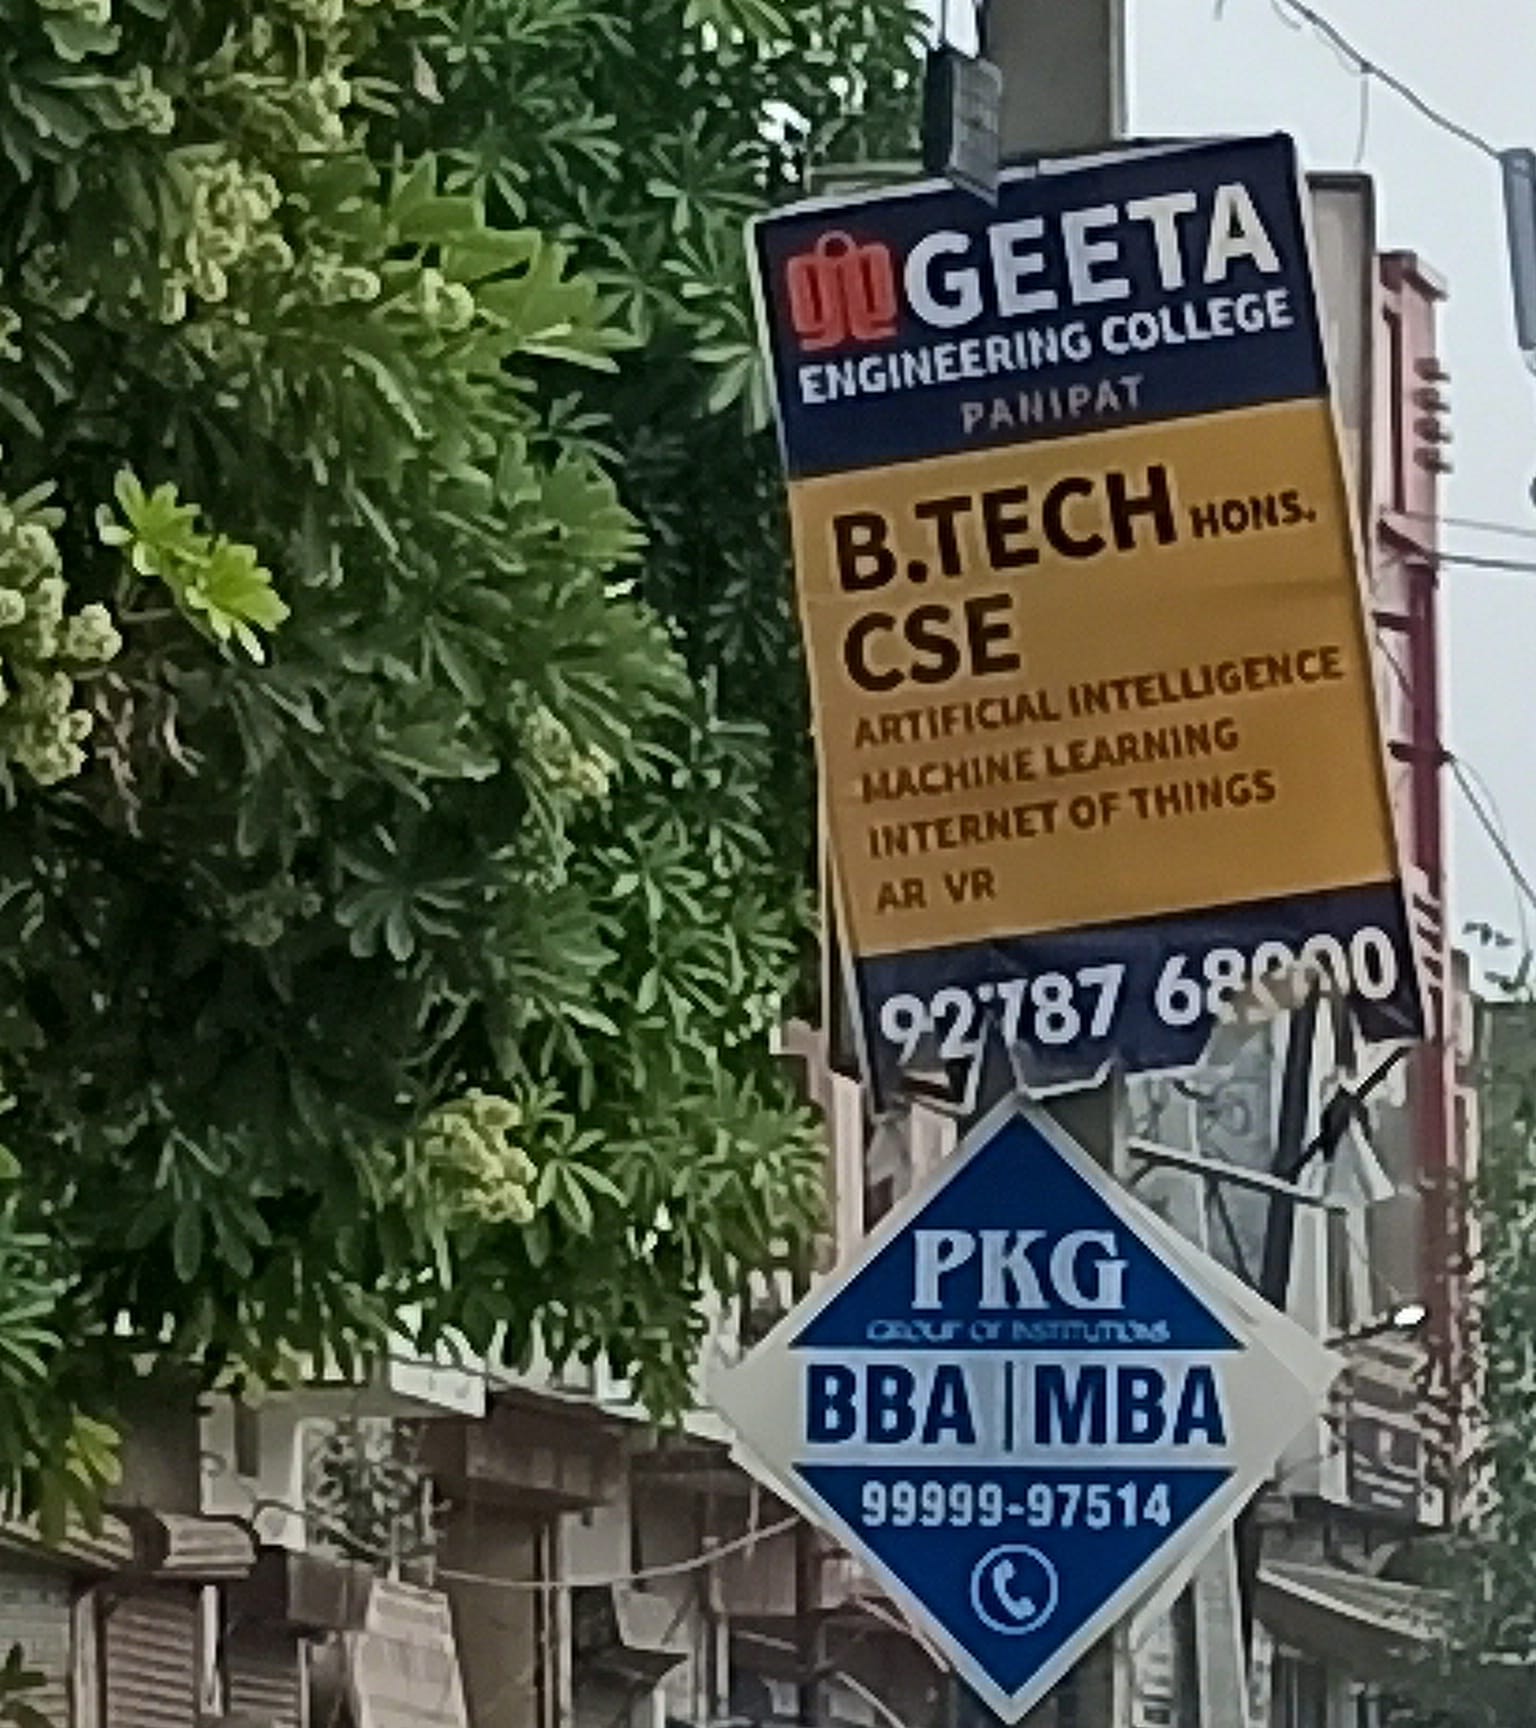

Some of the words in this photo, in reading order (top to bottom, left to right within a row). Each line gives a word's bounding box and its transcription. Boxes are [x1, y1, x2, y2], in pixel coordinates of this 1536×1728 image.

[905, 184, 1280, 330] GEETA
[799, 322, 1092, 403] ENGINEERING
[1101, 290, 1294, 356] COLLEGE
[961, 376, 1145, 434] PANIPAT
[832, 464, 1178, 592] B.TECH
[1190, 491, 1317, 538] HONS.
[843, 595, 1022, 692] CSE
[853, 692, 1061, 750] ARTIFICIAL
[1069, 647, 1344, 713] INTELLIGENCE
[862, 752, 1036, 803] MACHINE
[1044, 717, 1240, 777] LEARNING
[869, 802, 1059, 859] INTERNET
[1069, 791, 1120, 830] OF
[1129, 770, 1277, 822] THINGS
[876, 874, 928, 913] AR
[945, 869, 997, 905] VR
[911, 1229, 1127, 1310] PKG
[805, 1364, 977, 1446] BBA
[1032, 1364, 1228, 1447] MBA
[861, 1480, 1171, 1528] 99999-97514
